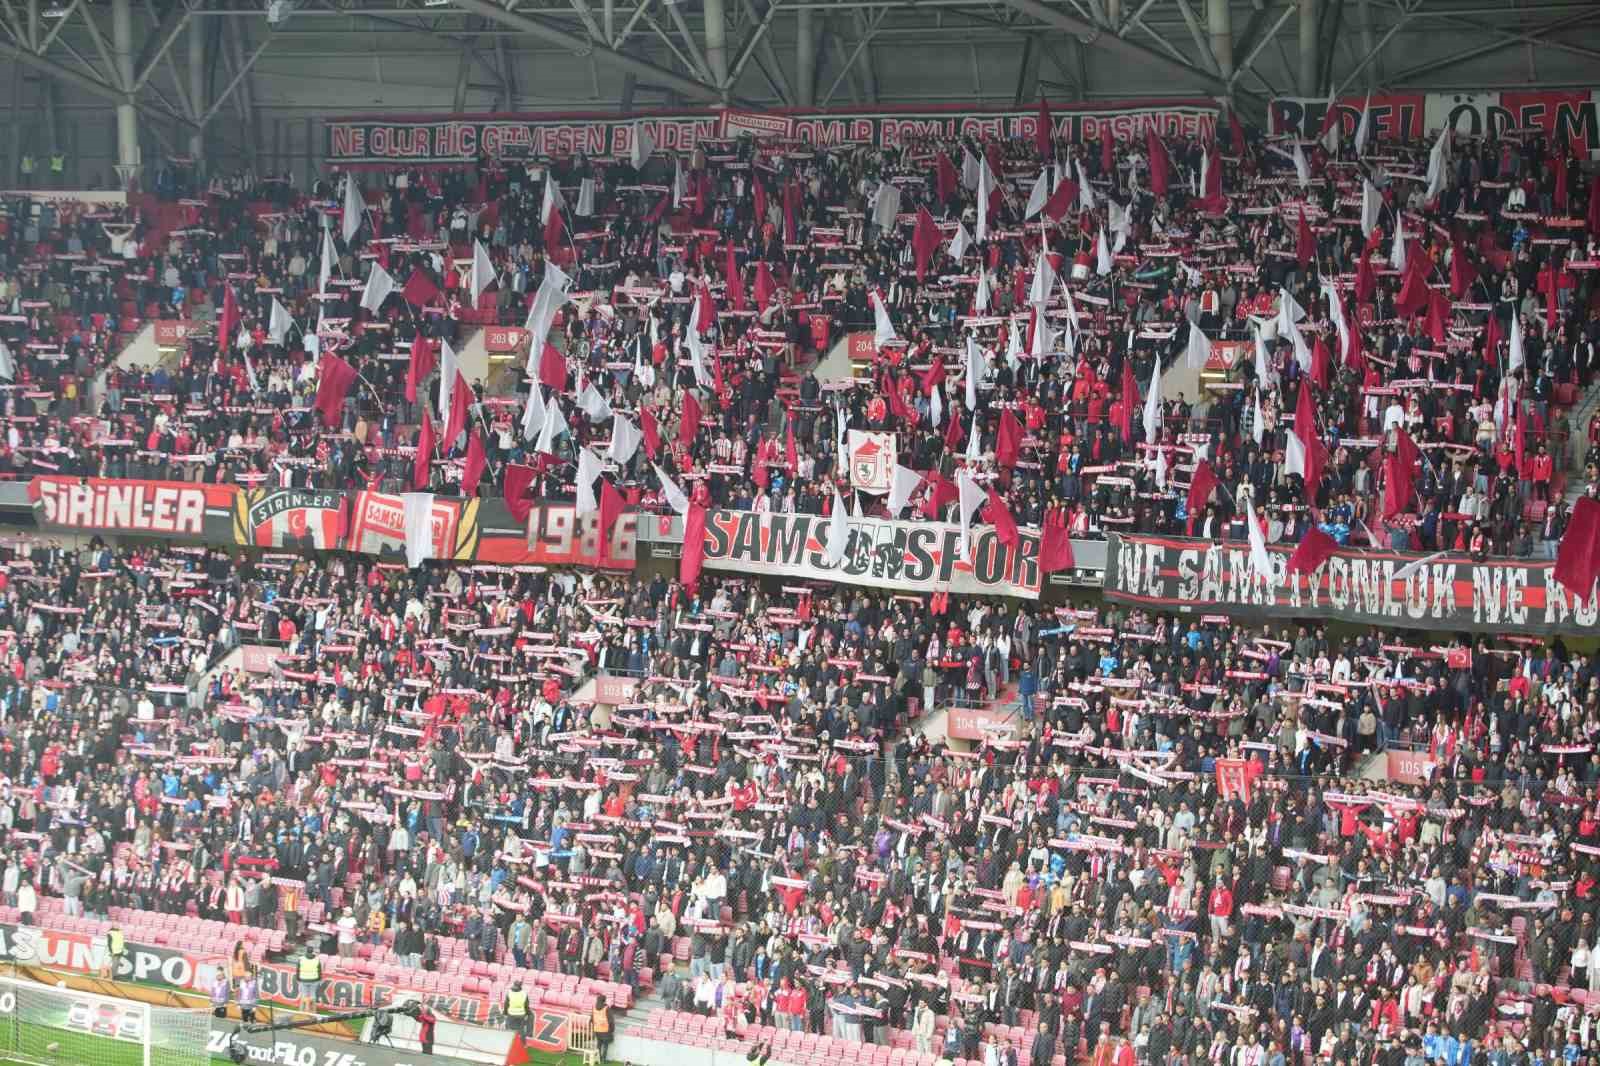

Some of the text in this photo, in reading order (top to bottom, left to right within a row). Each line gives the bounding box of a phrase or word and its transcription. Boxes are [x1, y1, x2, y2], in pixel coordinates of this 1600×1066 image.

[332, 126, 365, 156] NE
[370, 126, 430, 157] OLUR
[487, 332, 506, 344] 203
[855, 340, 873, 352] 204
[527, 506, 637, 561] 1986
[1117, 543, 1166, 596] NE
[1471, 565, 1528, 625] NE
[1399, 759, 1420, 776] 105
[259, 966, 300, 999] BU
[316, 980, 393, 1008] KALE
